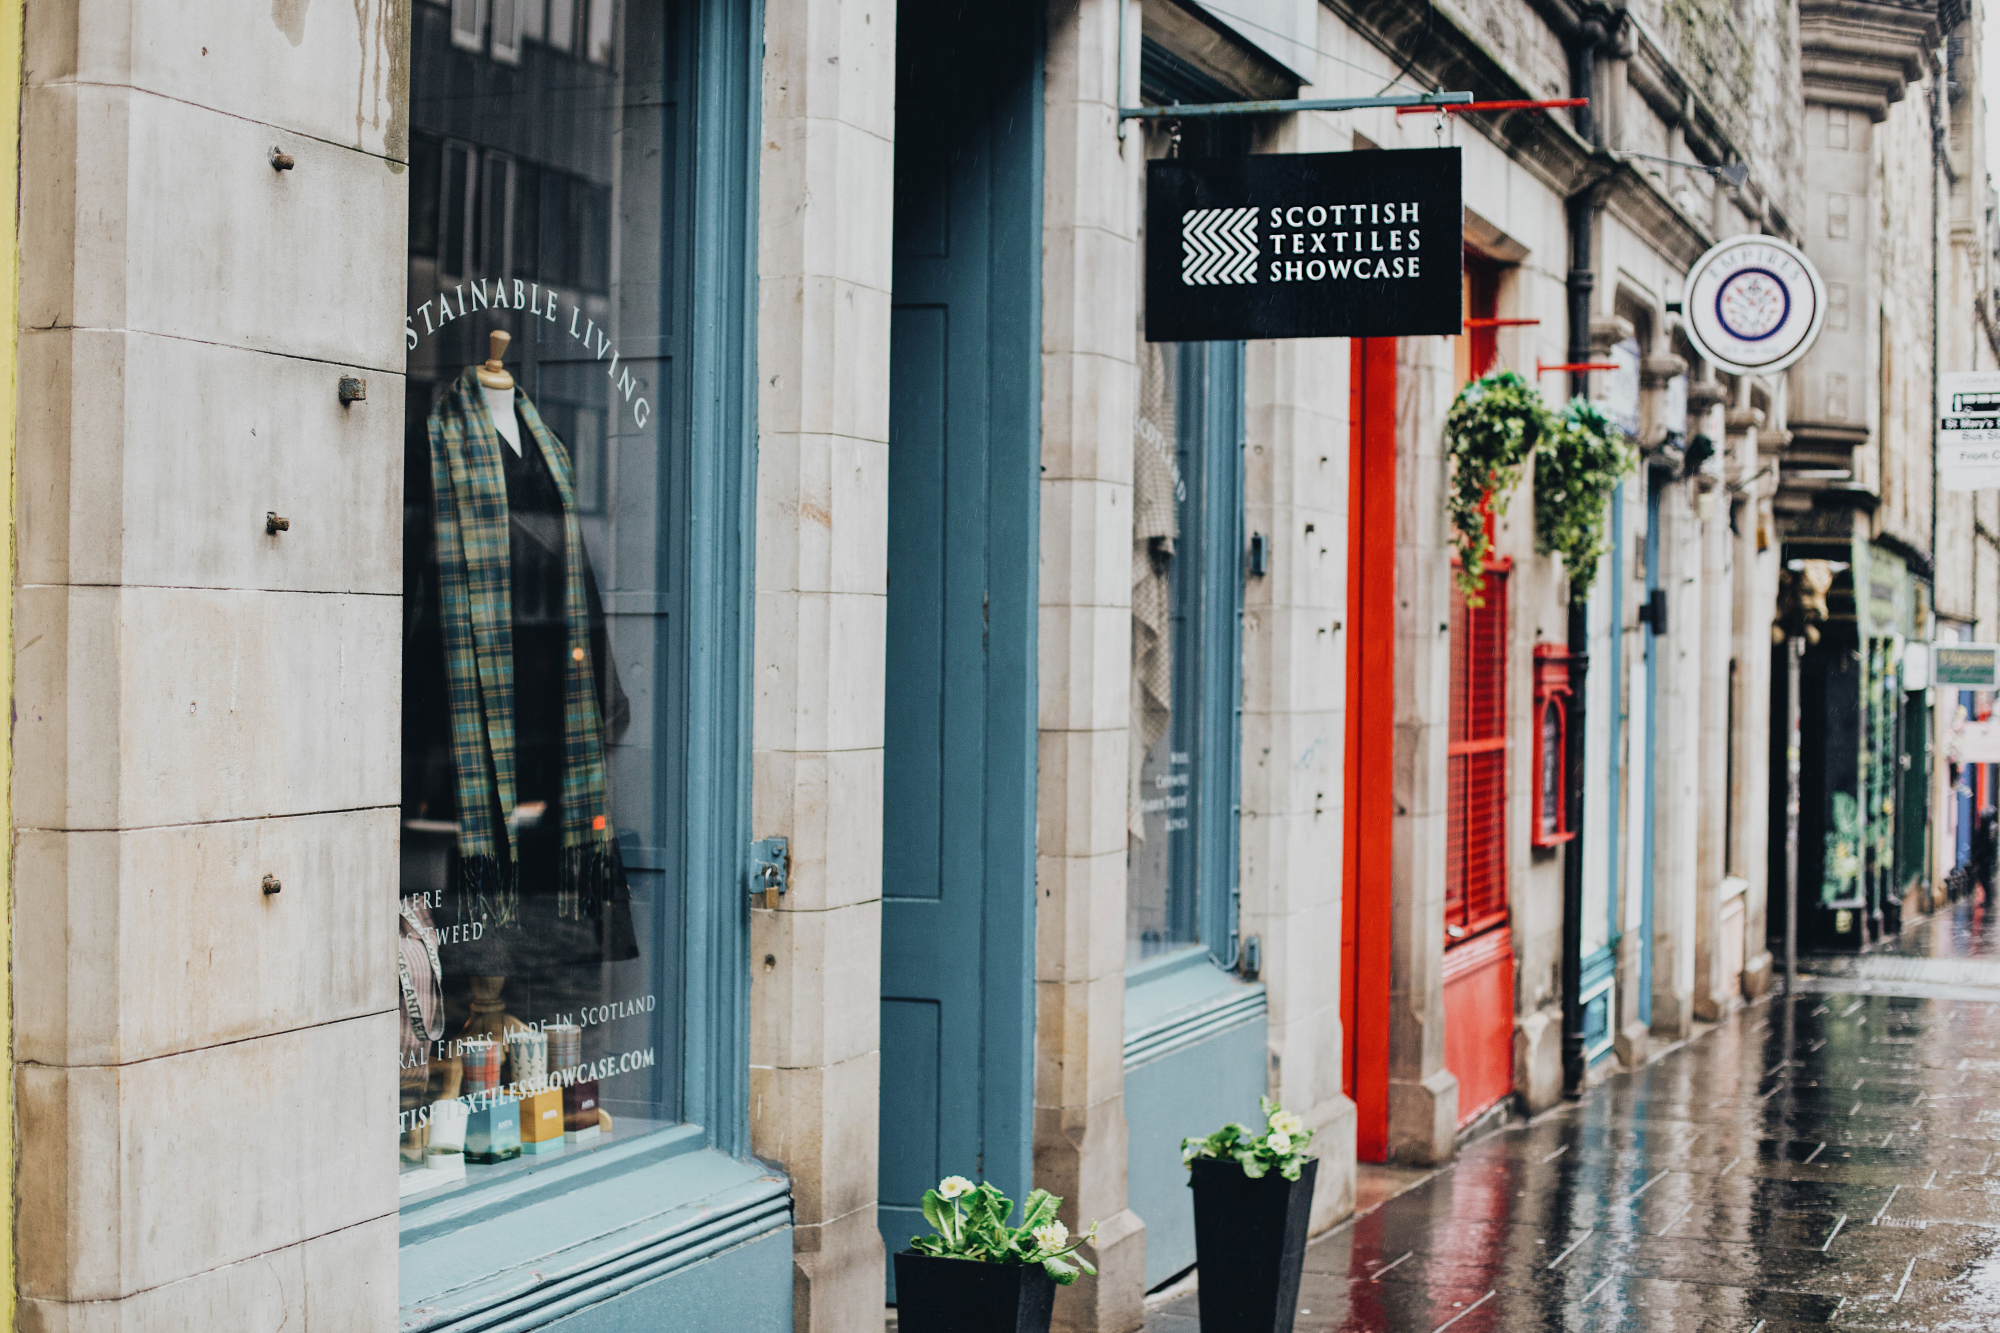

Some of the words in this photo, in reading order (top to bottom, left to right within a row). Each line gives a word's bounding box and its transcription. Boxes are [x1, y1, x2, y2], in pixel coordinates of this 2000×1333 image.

[1269, 202, 1419, 229] SCOTTISH
[1269, 229, 1421, 255] TEXTILES
[1269, 257, 1420, 282] SHOWCASE
[406, 277, 558, 350] STAINABLE
[569, 305, 651, 429] LIVING
[438, 1031, 494, 1062] FIBRES
[503, 1018, 548, 1046] MADE
[556, 1012, 574, 1033] IN
[581, 995, 656, 1028] SCOTLAND
